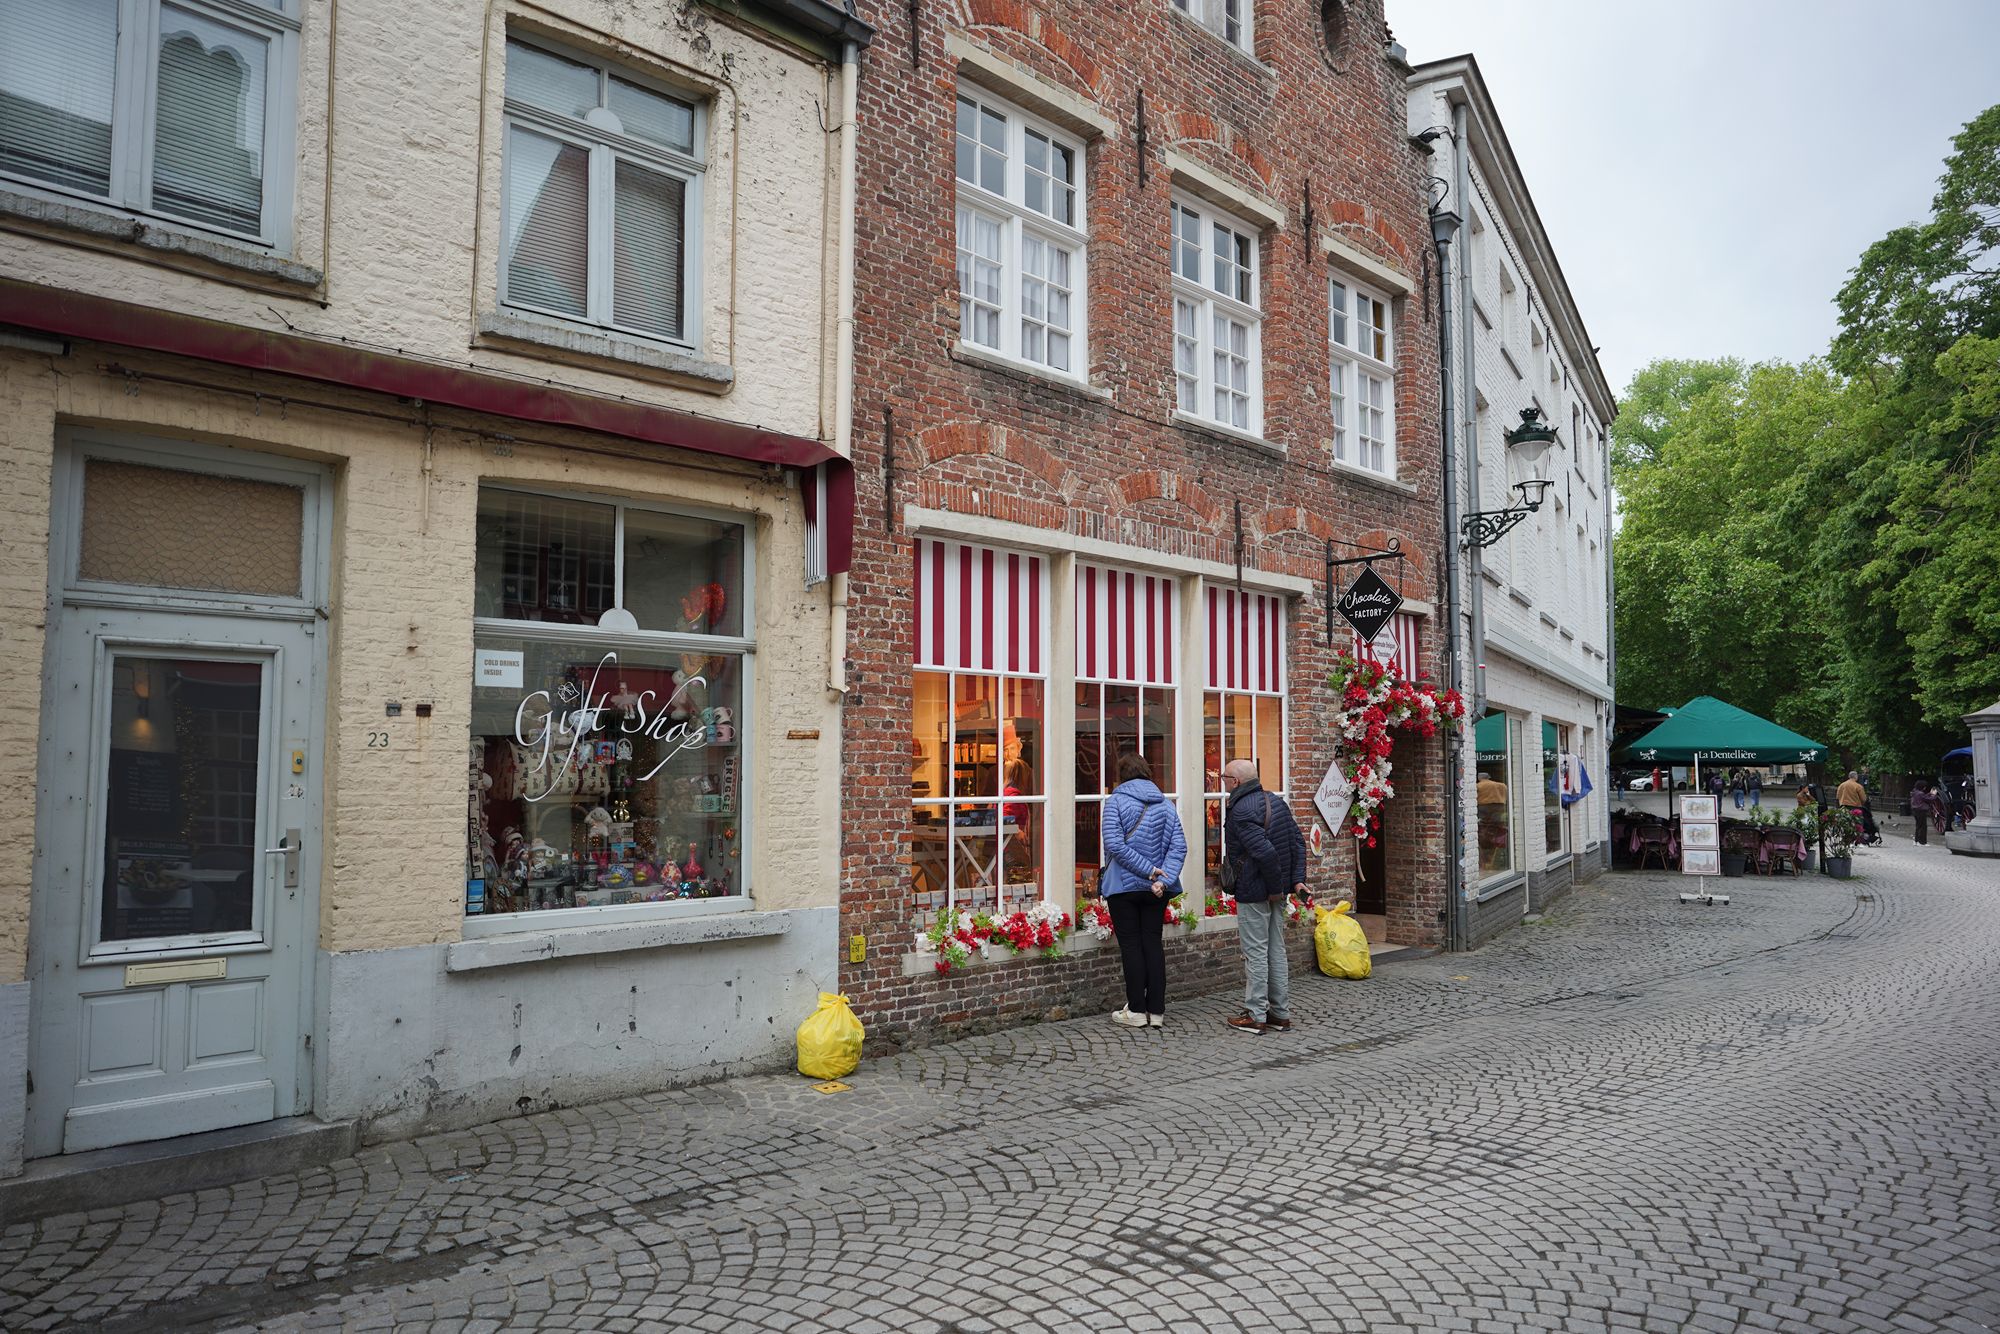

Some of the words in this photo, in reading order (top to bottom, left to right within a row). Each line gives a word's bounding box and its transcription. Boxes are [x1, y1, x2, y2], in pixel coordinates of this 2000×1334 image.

[1344, 587, 1392, 610] Chocolate
[1354, 607, 1383, 619] FACTORY
[483, 658, 499, 667] COLD
[499, 658, 520, 668] DRINKS
[483, 668, 503, 677] INSIDE
[514, 651, 618, 803] Gift
[620, 675, 708, 782] Shop
[367, 731, 389, 748] 23
[1334, 744, 1344, 759] 25
[1698, 750, 1709, 760] La
[1710, 749, 1757, 760] Dentellière
[722, 758, 734, 812] BRUGGE
